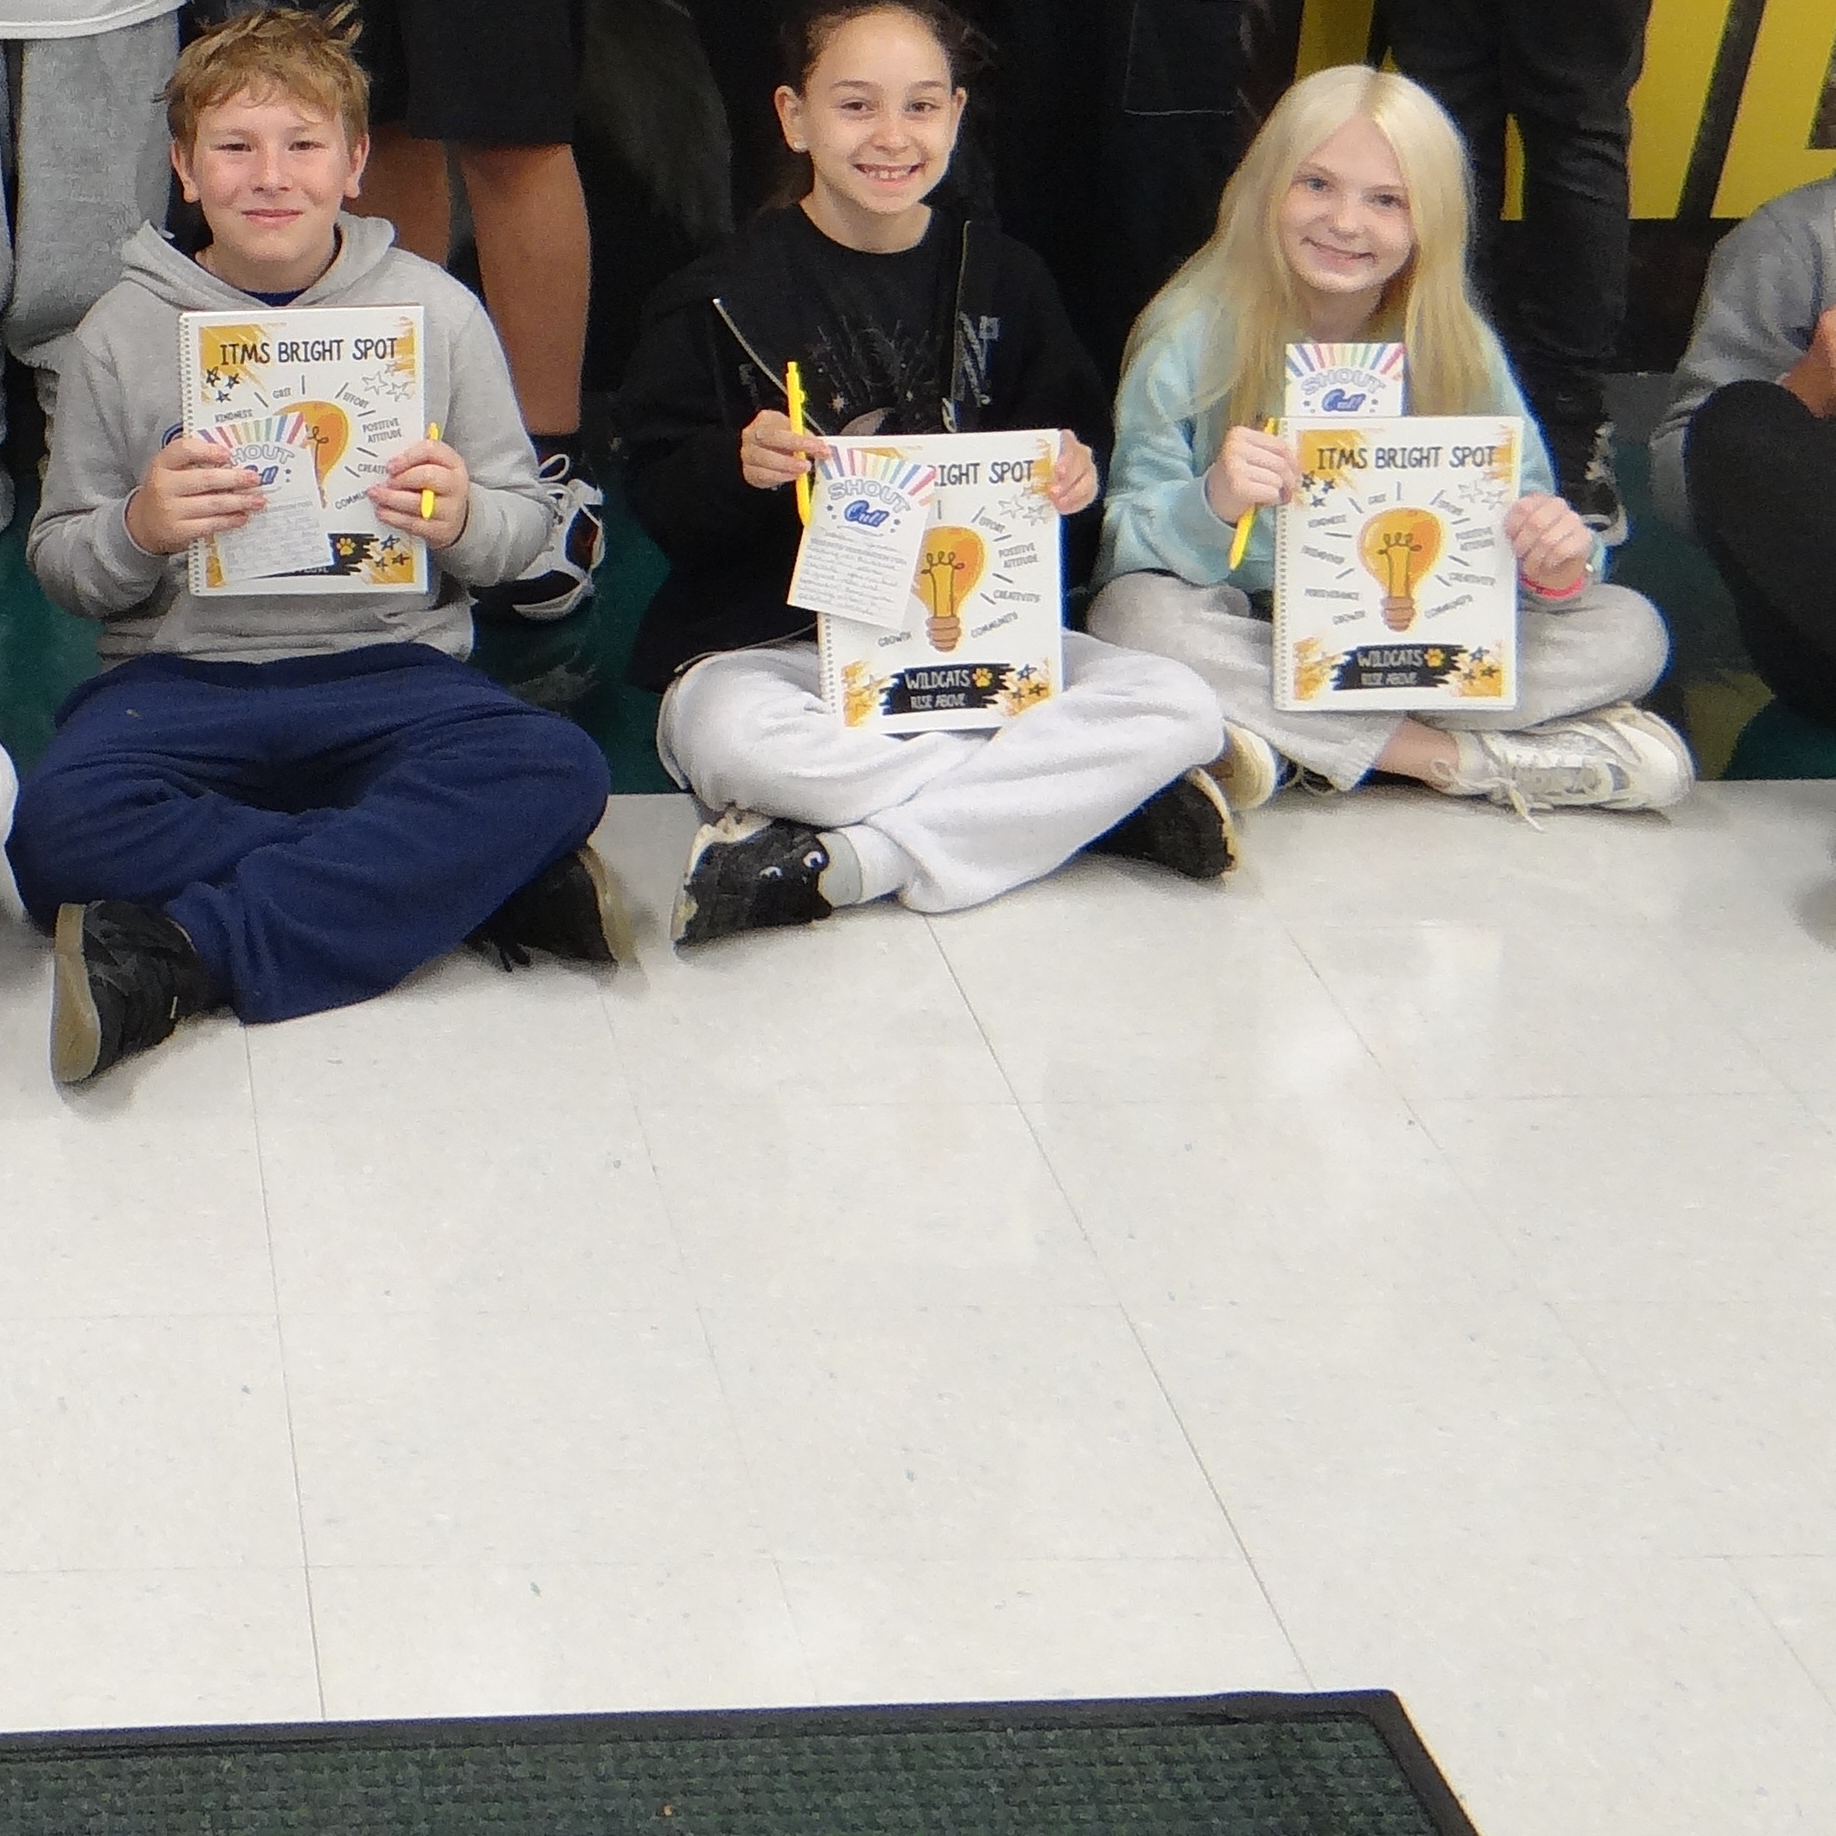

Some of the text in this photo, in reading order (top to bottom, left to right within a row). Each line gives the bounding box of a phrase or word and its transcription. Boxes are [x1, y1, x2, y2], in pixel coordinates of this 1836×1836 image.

[220, 337, 397, 365] ITMS BRIGHT SPOT
[1300, 368, 1386, 396] SHOUT
[343, 392, 369, 409] EFFORT
[362, 418, 399, 433] POSITIVE
[367, 429, 402, 443] ATTITUDE
[230, 444, 295, 467] HOUT
[1317, 445, 1496, 470] ITMS BRIGHT SPOT
[989, 460, 1034, 483] SPOT
[829, 479, 910, 513] SHOUT
[998, 543, 1035, 557] POSITIVE
[877, 632, 913, 648] GROWTH
[1357, 649, 1423, 667] WILDCATS
[904, 669, 970, 689] WILDCATS
